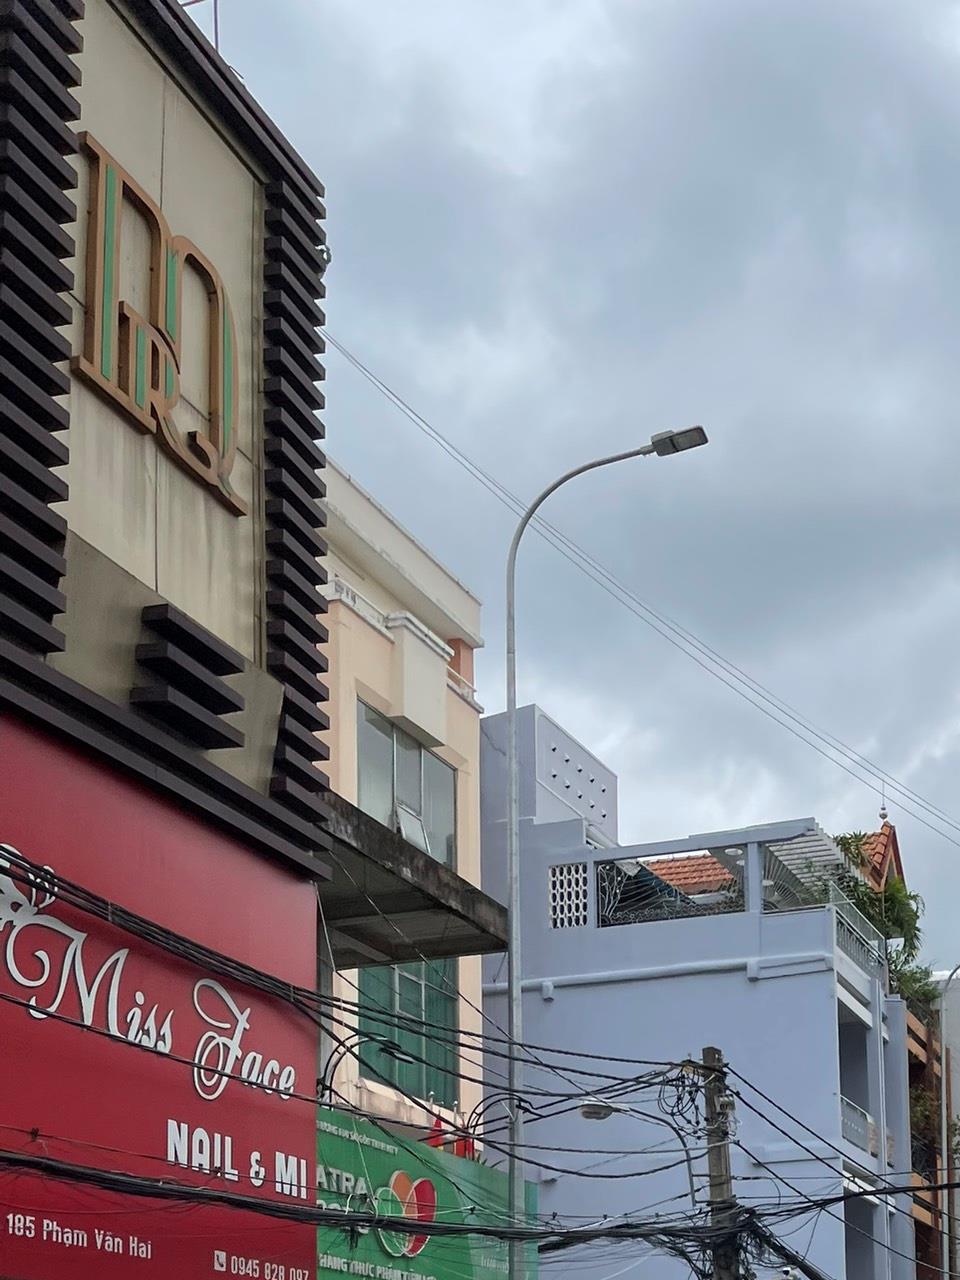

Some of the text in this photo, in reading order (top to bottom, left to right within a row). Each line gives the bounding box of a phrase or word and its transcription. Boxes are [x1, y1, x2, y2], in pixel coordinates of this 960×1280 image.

[6, 914, 296, 1100] Miss Face
[167, 1119, 308, 1199] NAIL & MI
[6, 1213, 36, 1238] 185
[42, 1219, 88, 1248] Phạm
[129, 1235, 152, 1259] Hai
[230, 1255, 260, 1278] 0945
